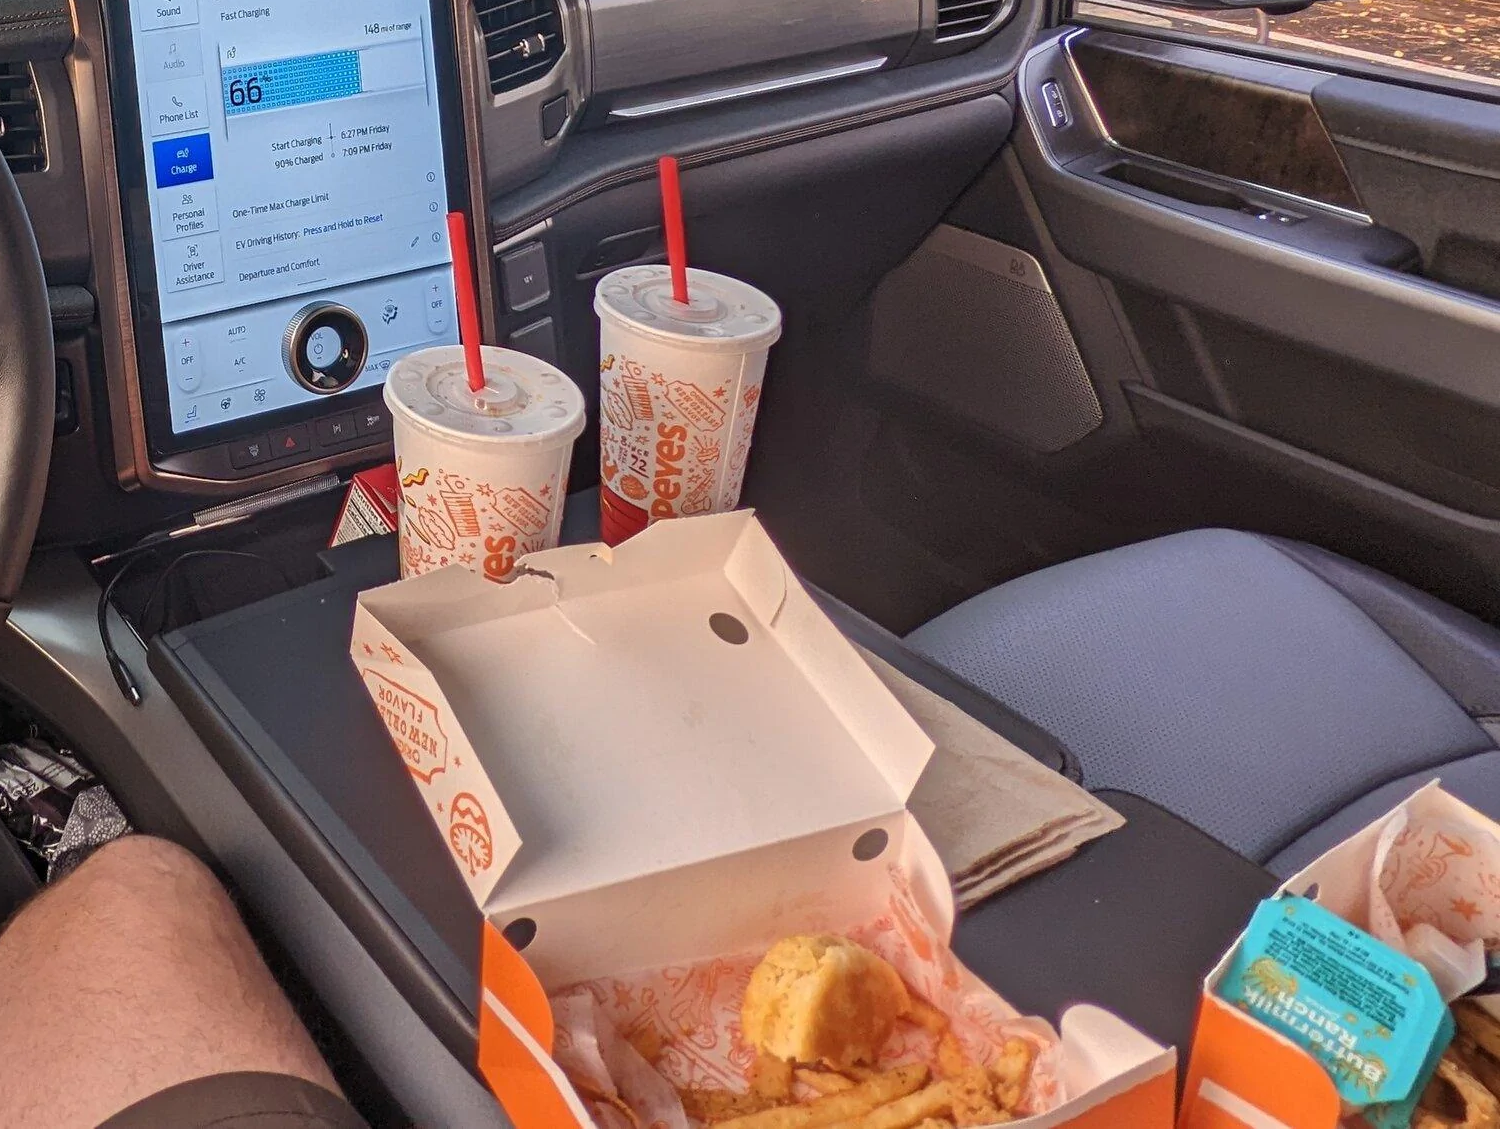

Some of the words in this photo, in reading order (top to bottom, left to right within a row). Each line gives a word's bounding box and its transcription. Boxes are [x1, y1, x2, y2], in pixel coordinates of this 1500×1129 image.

[156, 5, 181, 17] Sound
[220, 10, 239, 21] Fast
[238, 6, 271, 20] Charging
[364, 23, 380, 35] 148
[395, 21, 412, 33] range
[163, 57, 185, 70] Audio
[159, 112, 183, 124] Phone
[184, 109, 199, 120] List
[340, 128, 356, 140] 6:27
[357, 126, 368, 137] PM
[368, 123, 390, 136] Friday
[271, 140, 289, 152] Start
[289, 134, 322, 149] Charging
[342, 145, 358, 158] 7:09
[358, 143, 370, 155] PM
[370, 140, 392, 154] Friday
[275, 158, 293, 170] 90%
[293, 152, 324, 167] Charged
[171, 163, 198, 175] Charge
[232, 205, 268, 218] One-Time
[269, 201, 285, 212] Max
[285, 197, 310, 209] Charge
[311, 192, 329, 204] Limit
[172, 208, 205, 222] Personal
[176, 221, 204, 233] Profiles
[235, 240, 247, 250] EV
[247, 236, 273, 248] Driving
[273, 230, 301, 243] History:
[303, 225, 322, 236] Press
[323, 222, 337, 232] and
[337, 218, 354, 229] Hold
[355, 217, 363, 226] to
[364, 214, 383, 224] Reset
[183, 261, 205, 273] Driver
[239, 267, 275, 282] Departure
[276, 263, 290, 274] and
[290, 258, 320, 271] Comfort
[176, 271, 215, 286] Assistance
[431, 298, 443, 310] OFF
[228, 326, 247, 336] AUTO
[181, 355, 194, 366] OFF
[234, 356, 247, 366] A/C
[651, 422, 688, 520] peyes
[379, 684, 423, 723] FLAVOR
[1277, 990, 1358, 1050] Ranch
